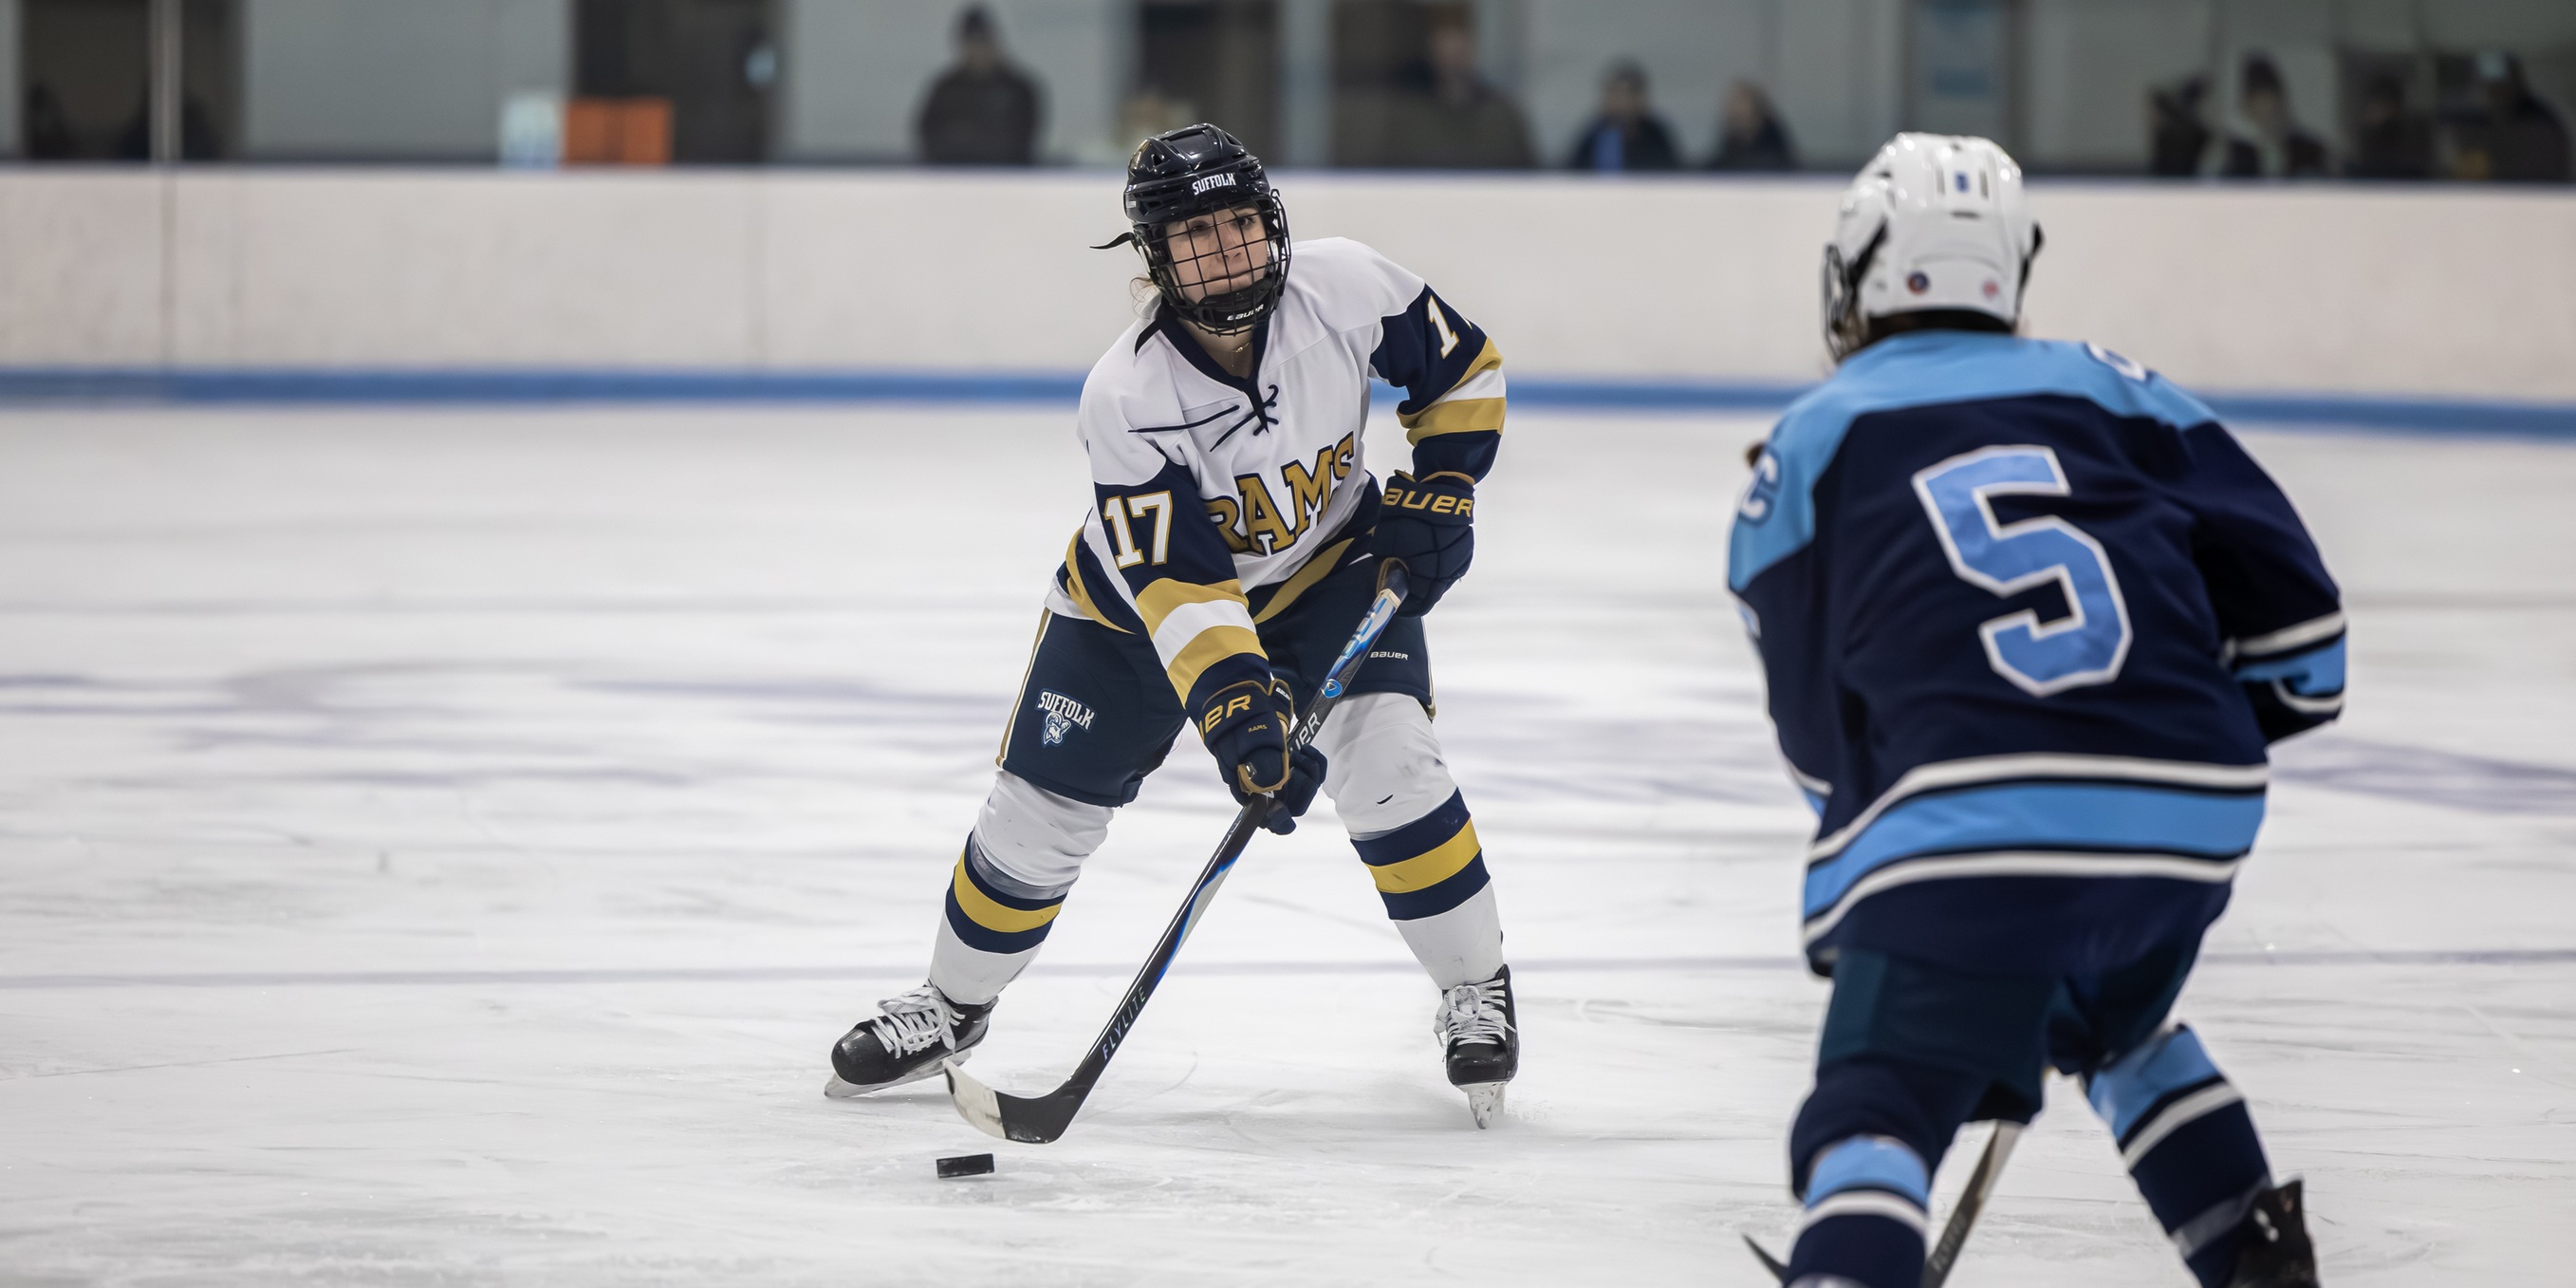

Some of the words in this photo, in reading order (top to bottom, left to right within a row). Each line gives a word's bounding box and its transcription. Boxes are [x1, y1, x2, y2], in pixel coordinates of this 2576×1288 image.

[1192, 173, 1236, 196] SUFFOLK
[1201, 430, 1355, 556] RAMS
[1381, 487, 1473, 518] AUER
[1103, 490, 1173, 570] 17
[1911, 444, 2133, 698] 5
[1370, 651, 1409, 661] BAUER
[1037, 691, 1095, 730] SUFFOLK
[1103, 986, 1145, 1060] FLYLITE
